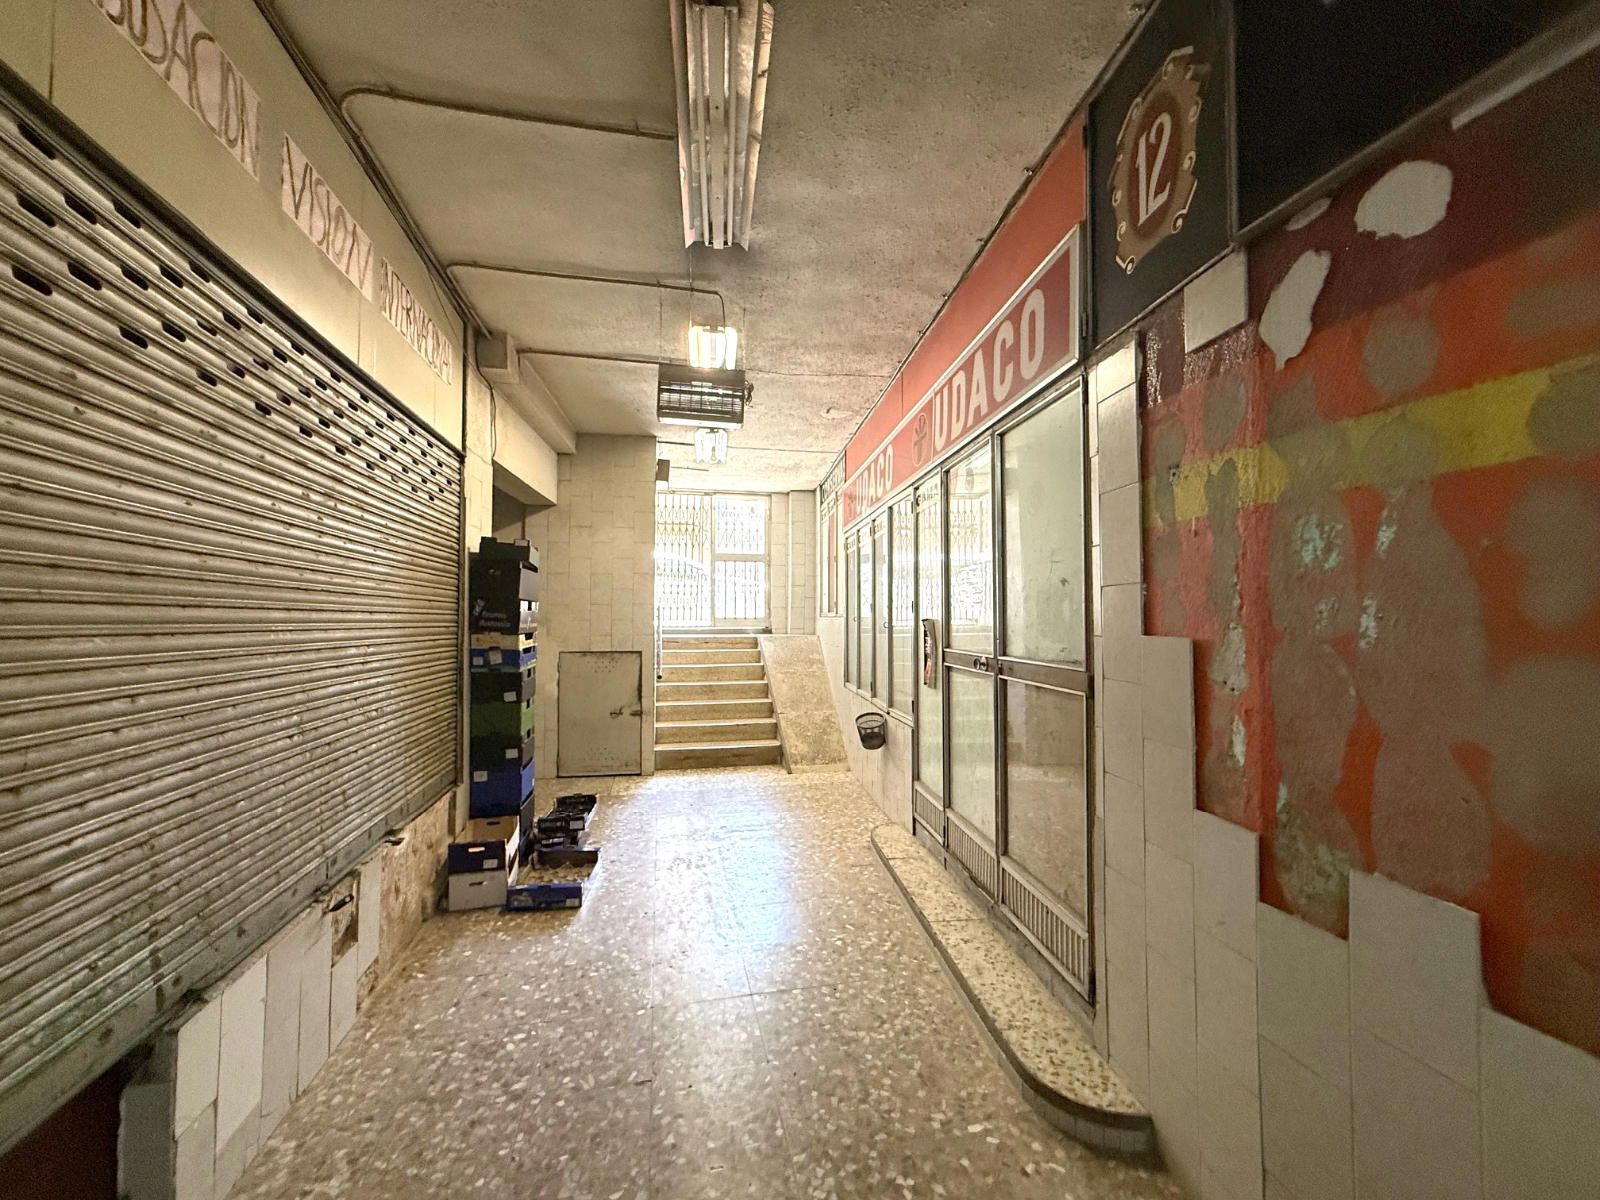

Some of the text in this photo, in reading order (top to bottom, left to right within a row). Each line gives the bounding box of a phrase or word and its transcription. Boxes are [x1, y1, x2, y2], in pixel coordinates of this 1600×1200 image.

[283, 135, 372, 290] VISION
[1136, 112, 1172, 226] 12
[935, 289, 1045, 451] UDACO
[856, 444, 893, 515] UDACO
